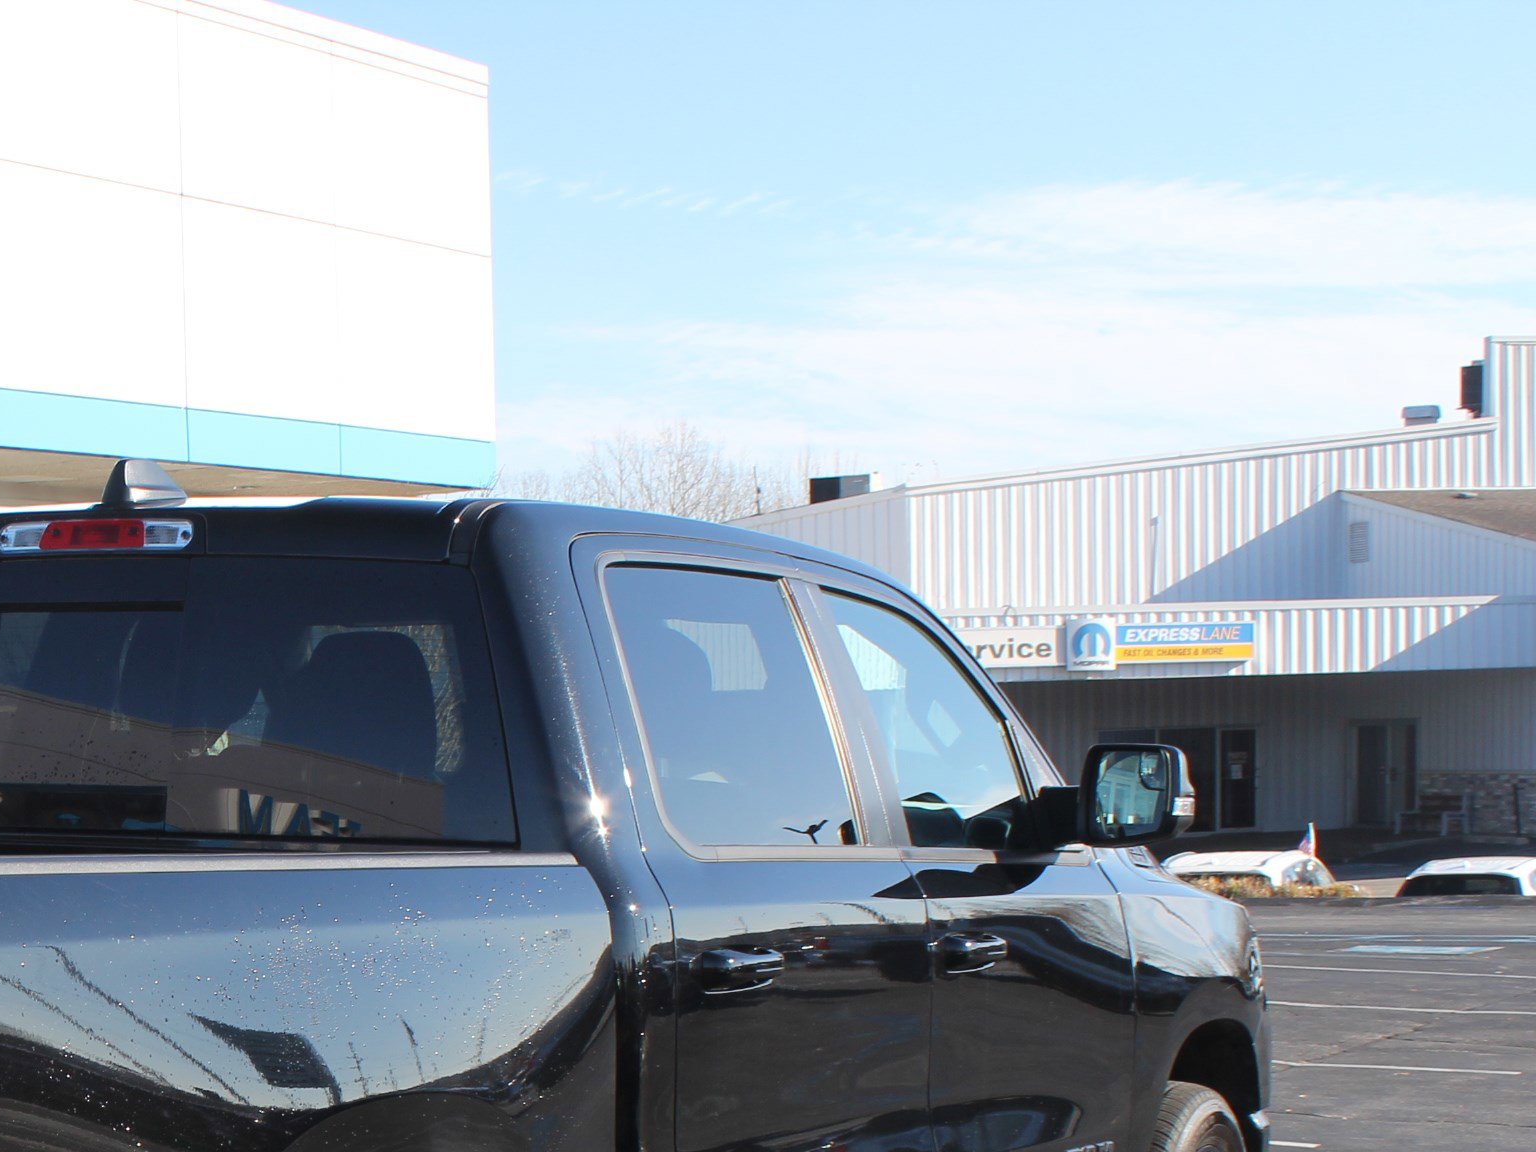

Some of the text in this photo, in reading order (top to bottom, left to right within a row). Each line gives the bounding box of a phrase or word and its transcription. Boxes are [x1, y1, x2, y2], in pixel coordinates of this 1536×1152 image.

[967, 638, 1052, 659] rvice
[1123, 649, 1141, 658] FAST
[1143, 649, 1154, 657] OIL
[1156, 648, 1192, 656] CHANGES
[1201, 647, 1224, 655] MORE
